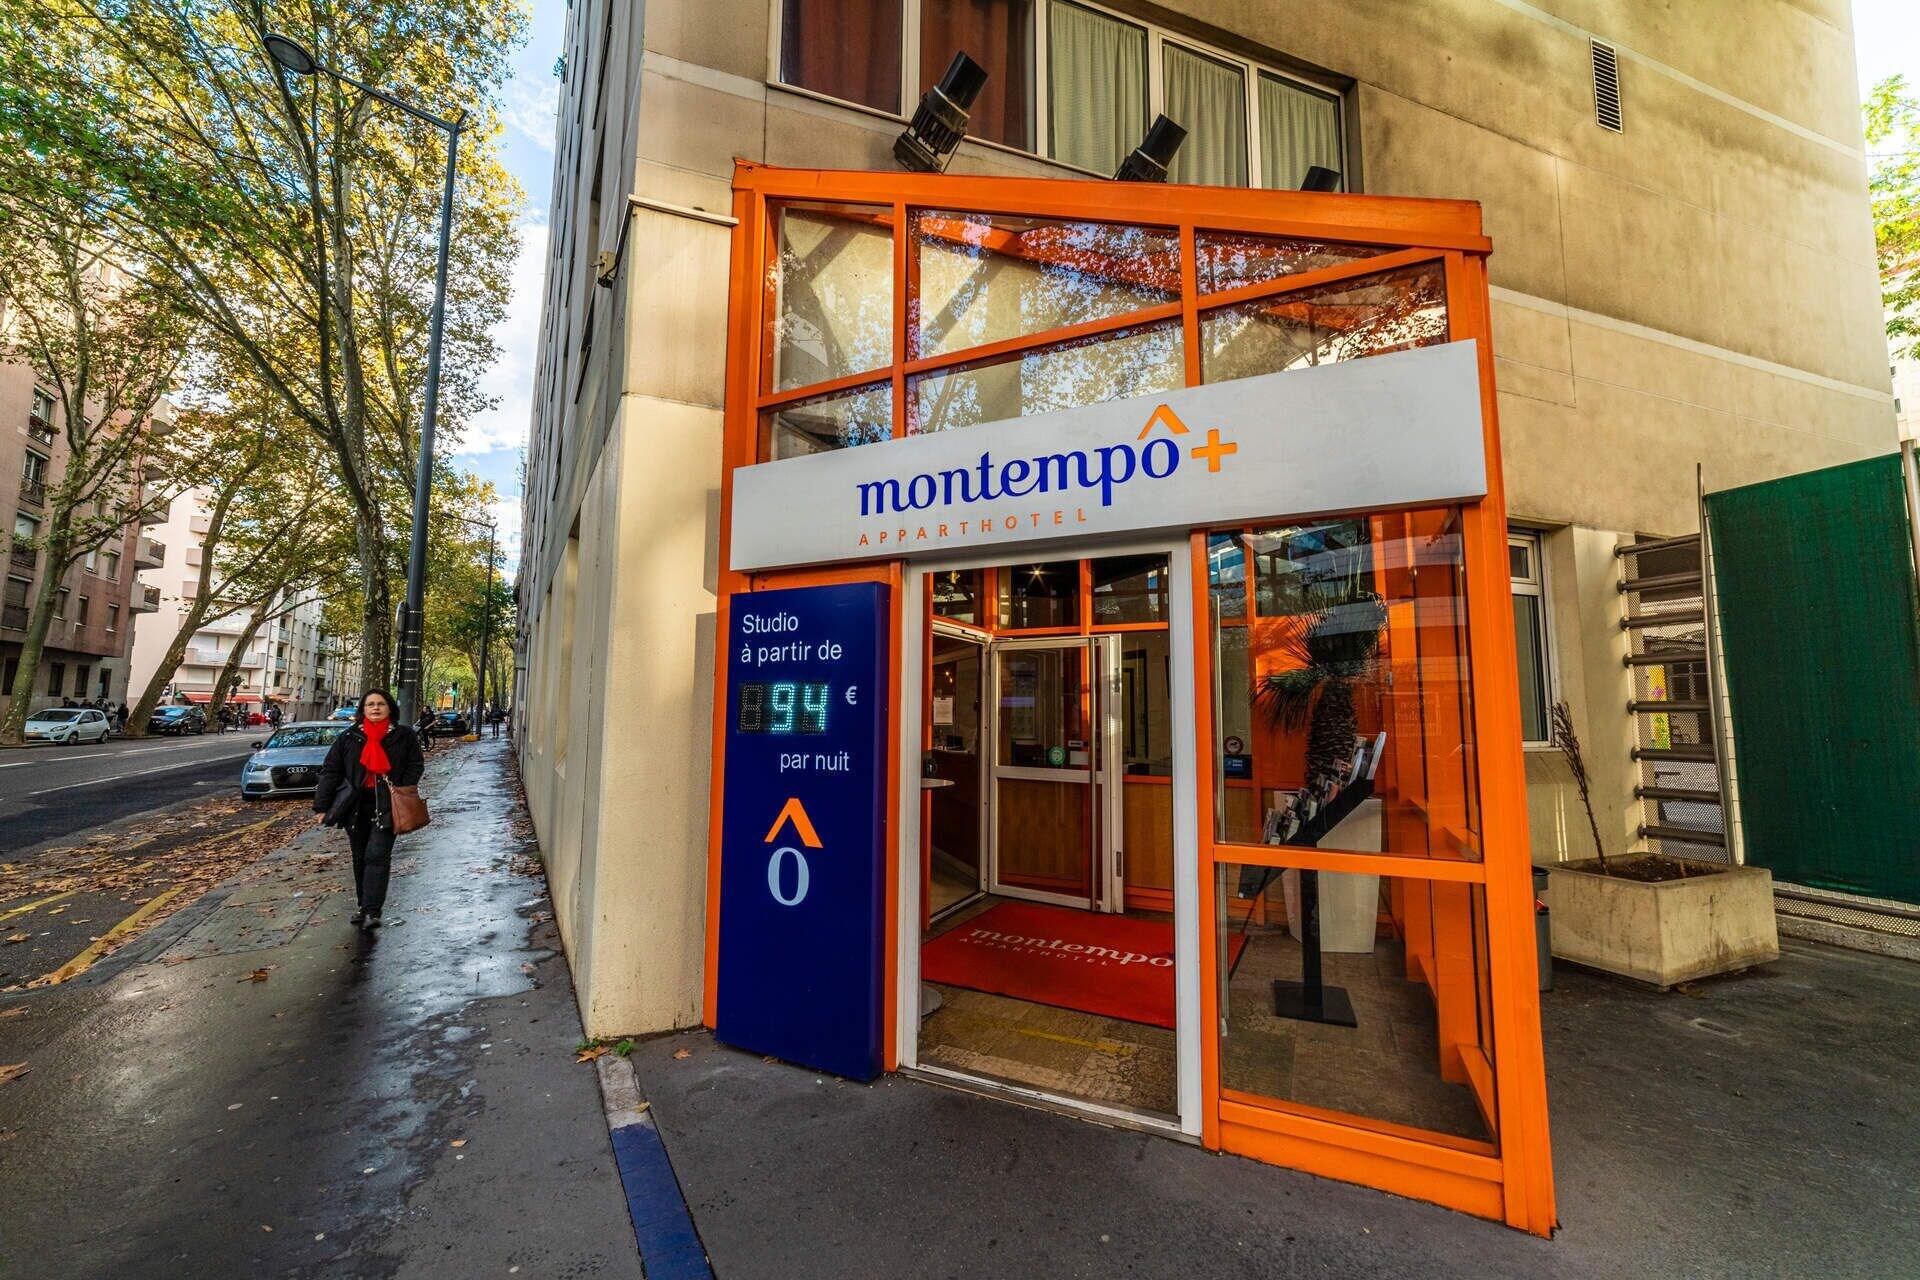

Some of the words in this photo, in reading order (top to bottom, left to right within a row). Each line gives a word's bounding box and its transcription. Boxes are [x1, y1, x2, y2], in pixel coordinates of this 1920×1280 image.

[859, 508, 1086, 546] APPARTHOTEL
[742, 612, 799, 634] Studio
[741, 643, 752, 664] à
[758, 641, 811, 667] partir
[818, 640, 843, 660] de
[771, 683, 829, 731] 94
[780, 752, 810, 774] par
[816, 751, 850, 771] nuit
